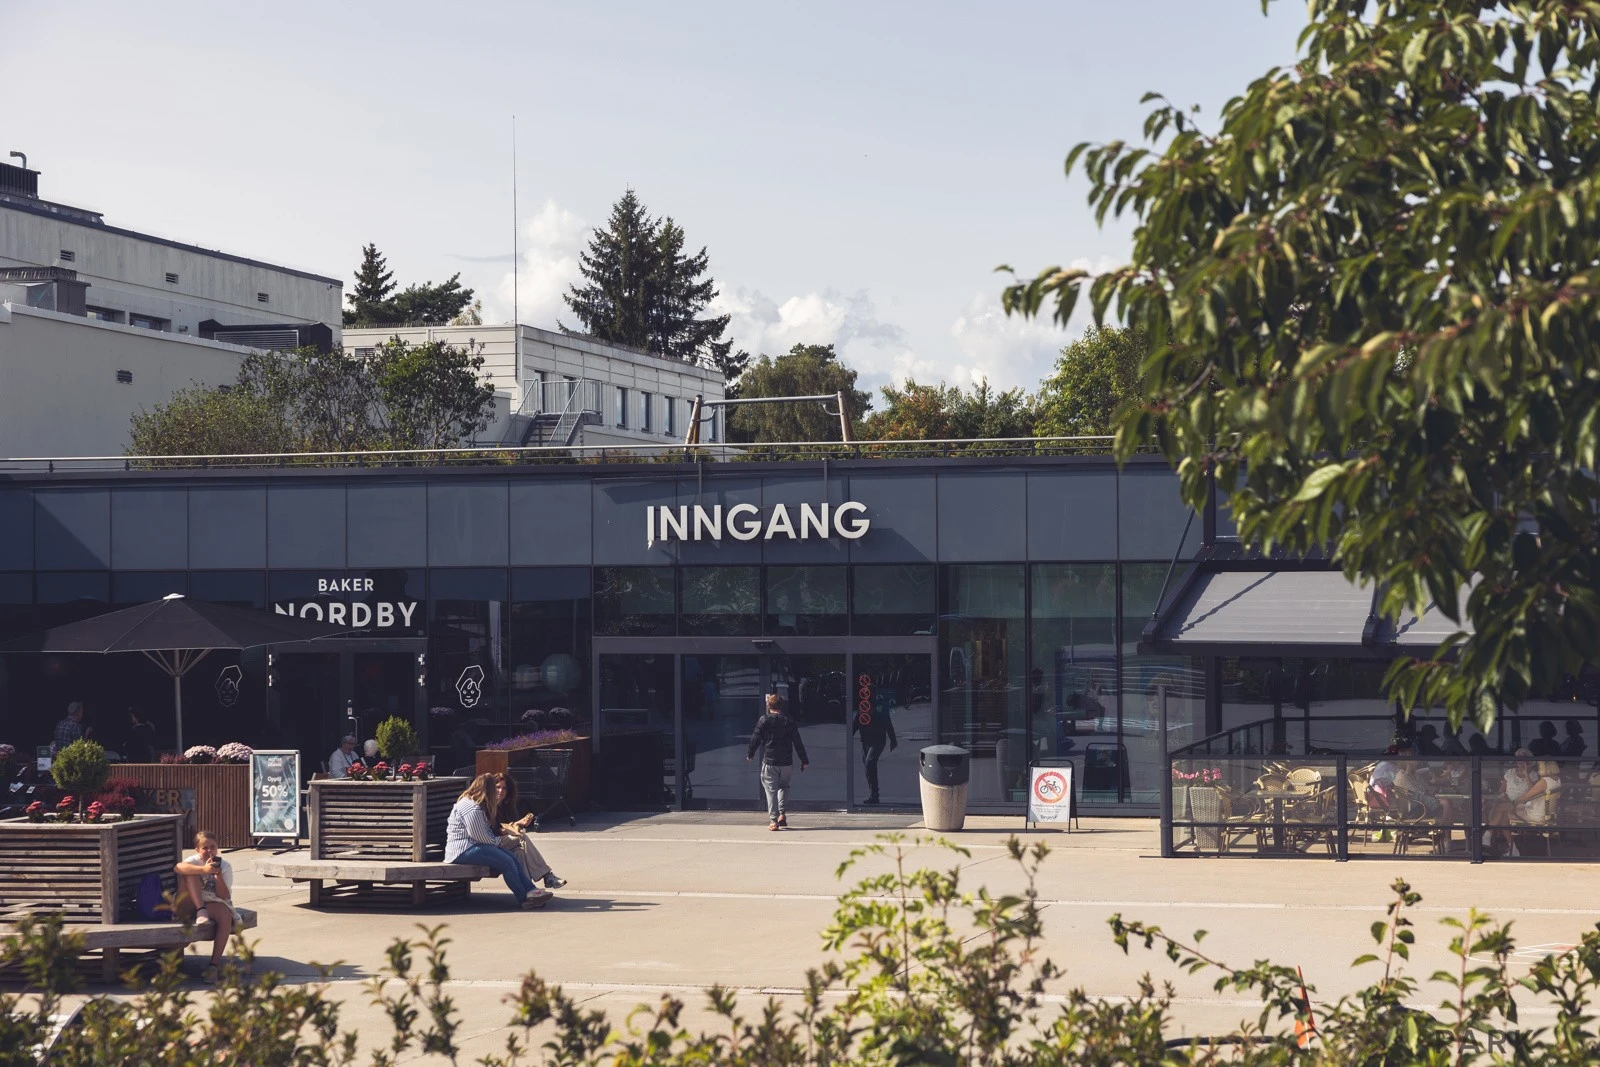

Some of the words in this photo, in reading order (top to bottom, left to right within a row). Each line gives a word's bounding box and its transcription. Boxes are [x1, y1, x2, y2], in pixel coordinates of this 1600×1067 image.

[647, 501, 871, 541] INNGANG
[318, 578, 374, 592] BAKER
[1148, 739, 1180, 747] GLSS
[261, 785, 288, 798] 50%
